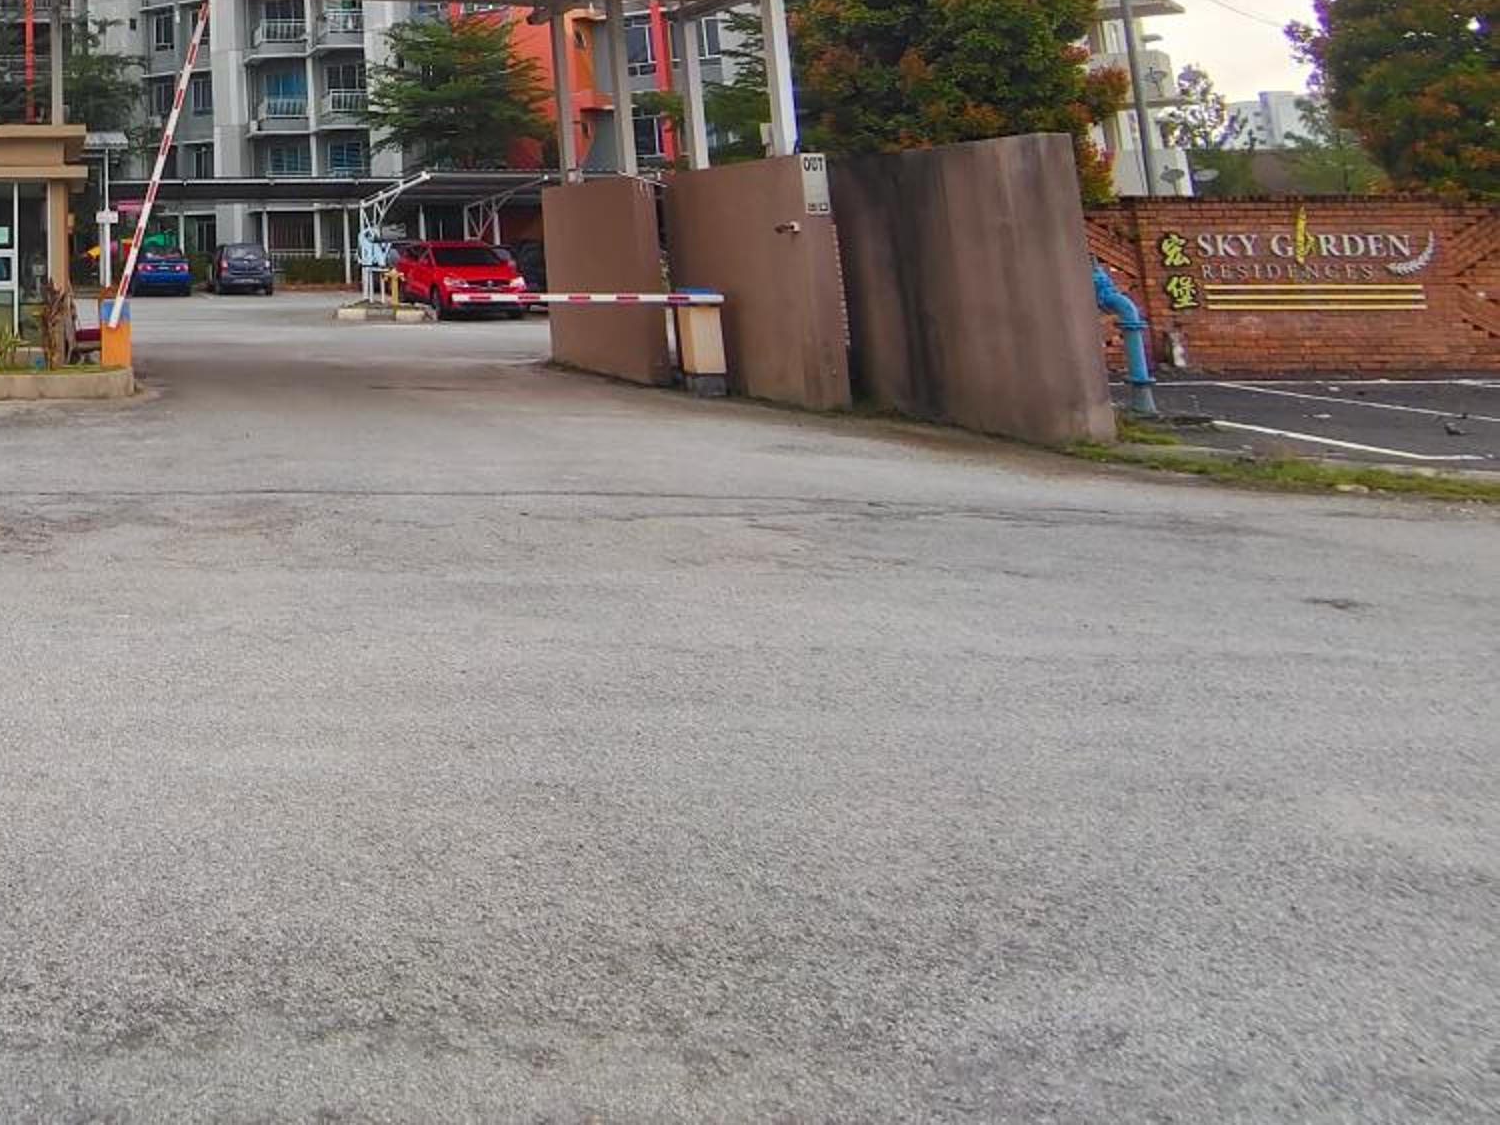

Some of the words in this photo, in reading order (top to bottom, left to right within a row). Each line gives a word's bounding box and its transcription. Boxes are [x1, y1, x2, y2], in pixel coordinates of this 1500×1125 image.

[804, 157, 823, 171] OUT
[1197, 234, 1258, 256] SKY
[1201, 263, 1375, 280] RESIDENCES
